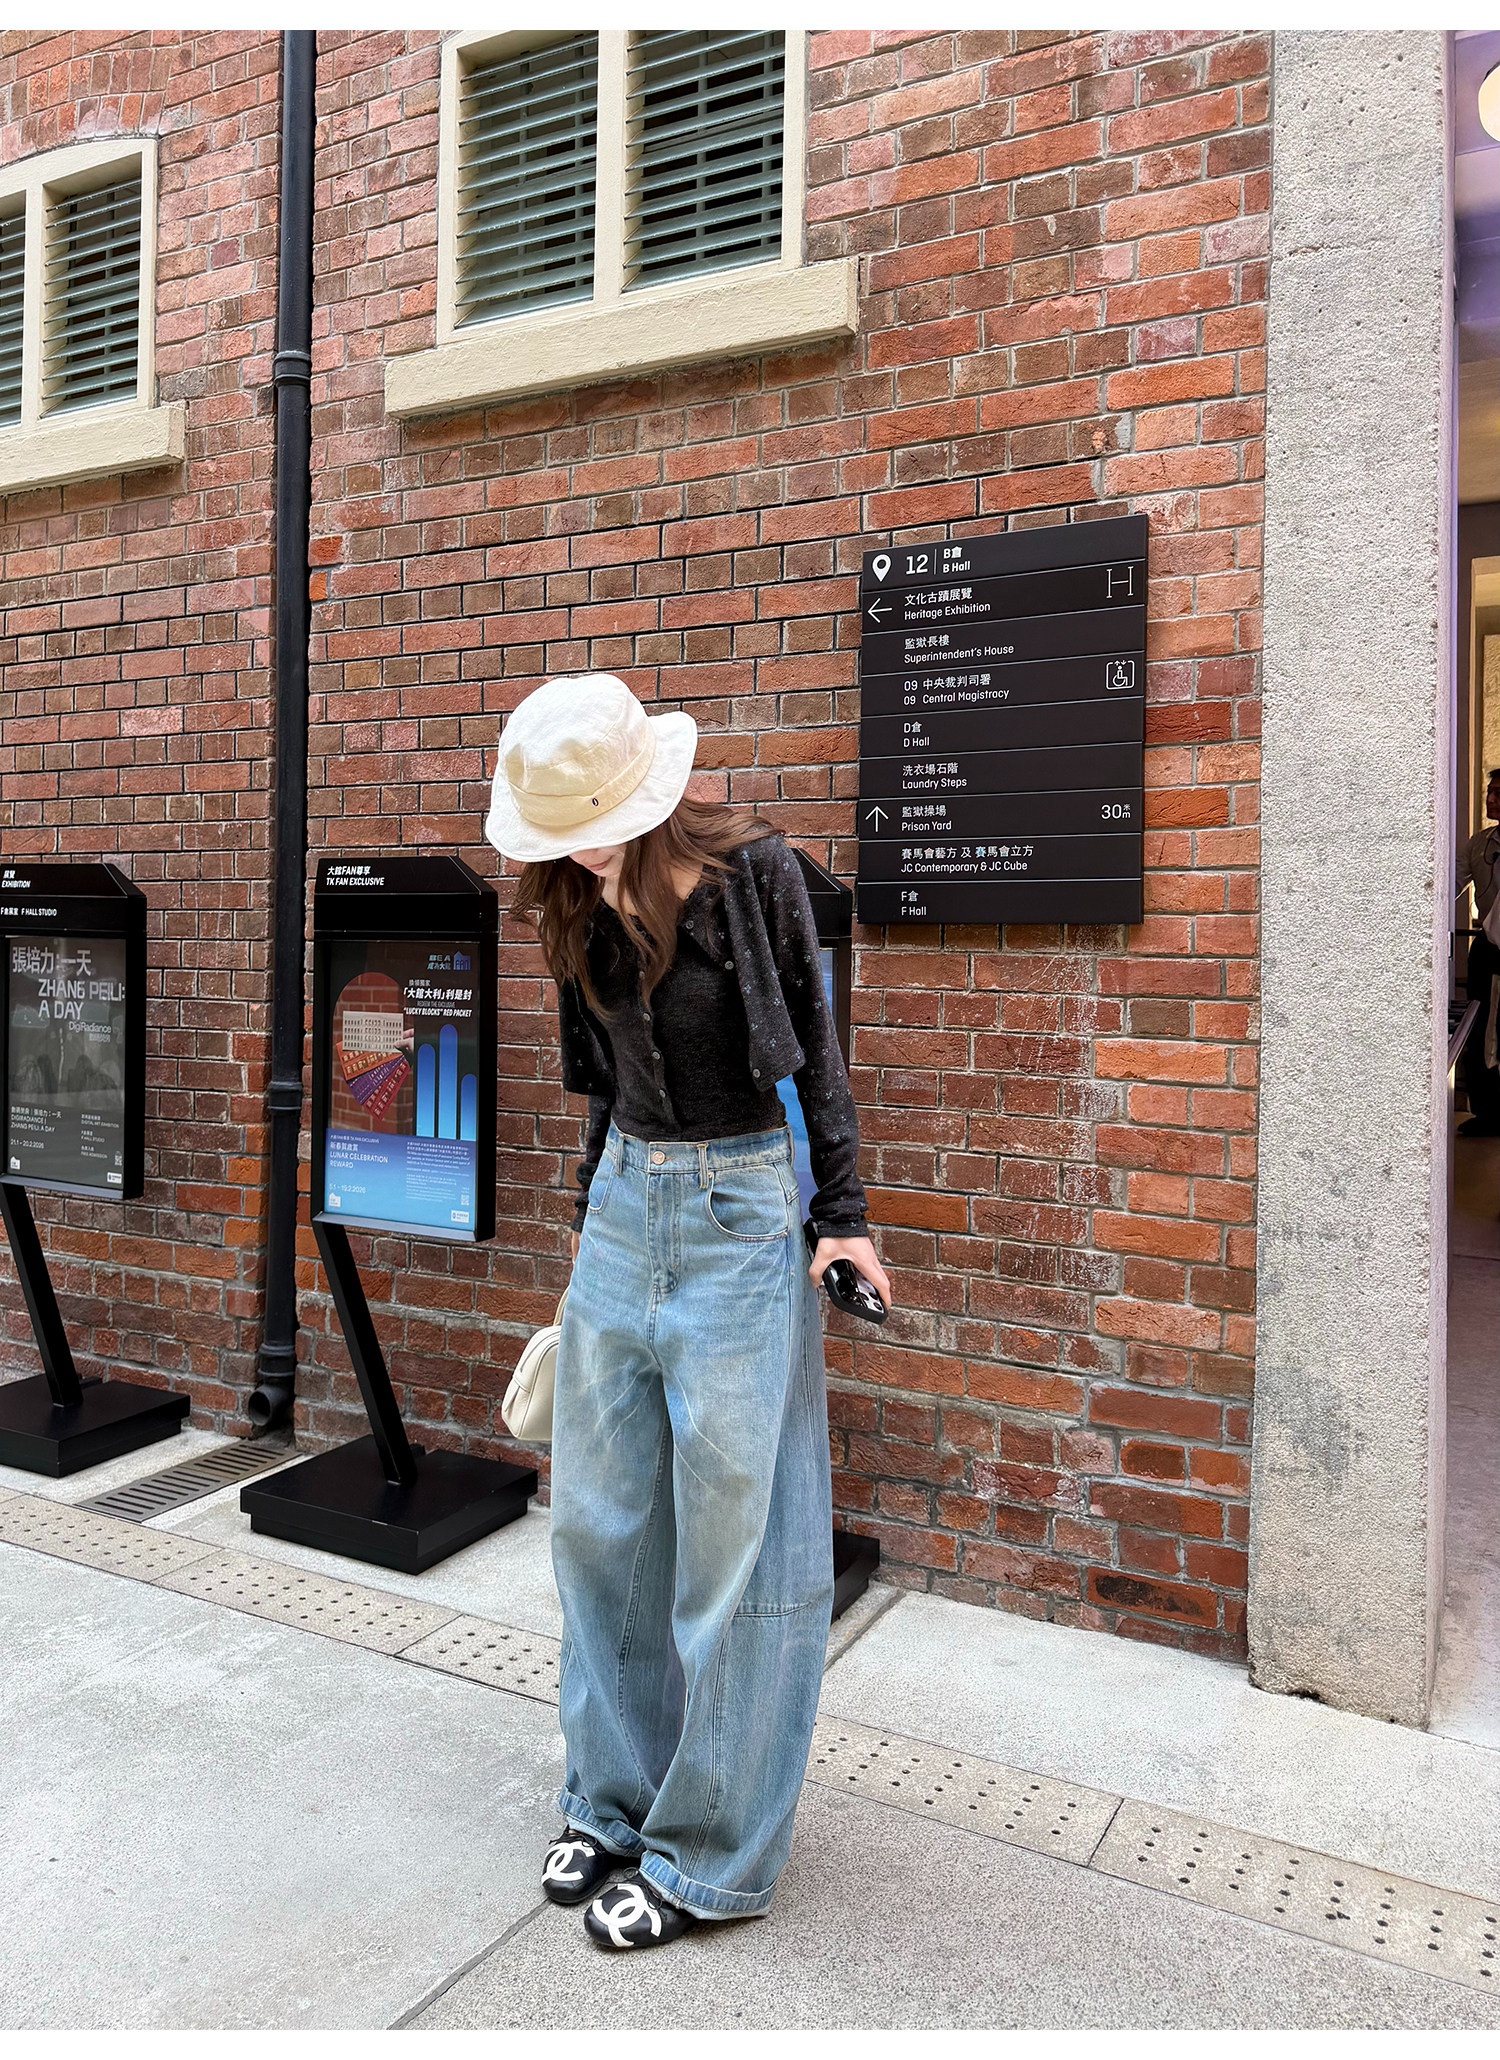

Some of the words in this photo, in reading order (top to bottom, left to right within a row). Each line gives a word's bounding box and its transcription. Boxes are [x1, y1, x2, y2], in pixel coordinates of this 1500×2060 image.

[944, 546, 962, 558] B倉
[906, 554, 928, 574] 12
[943, 564, 950, 574] B
[952, 561, 970, 572] Hall
[904, 587, 972, 607] 文化古蹟展覽
[904, 608, 943, 621] Heritage
[945, 602, 991, 616] Exhibition
[904, 634, 950, 650] 監獄長樓
[984, 644, 1014, 655] House
[904, 680, 918, 691] 09
[923, 673, 991, 690] 中央裁判司署
[904, 695, 916, 705] 09
[923, 692, 955, 704] Central
[958, 688, 1009, 701] Magistracy
[904, 721, 922, 734] D倉
[904, 738, 910, 747] D
[912, 737, 930, 747] Hall
[902, 762, 958, 776] 洗衣場石階
[902, 778, 939, 790] Laundry
[941, 777, 967, 788] Steps
[902, 805, 946, 818] 監獄操場
[1101, 804, 1121, 820] 30
[902, 821, 929, 831] Prison
[932, 821, 952, 830] Yard
[901, 847, 957, 860] 賽馬會藝方
[961, 846, 972, 858] 及
[975, 845, 1033, 858] 賽馬會立方
[901, 863, 913, 873] JC
[915, 862, 978, 874] Contemporary
[980, 862, 987, 872] &
[989, 861, 1001, 871] JC
[1004, 861, 1028, 871] Cube
[2, 880, 31, 888] EXHIBITION
[326, 878, 335, 886] TK
[335, 878, 348, 886] FAN
[349, 877, 385, 886] EXCLUSIVE
[901, 890, 918, 902] F倉
[38, 908, 57, 916] STUDIO
[901, 907, 906, 916] F
[909, 906, 927, 916] Hall
[38, 979, 85, 999] ZHANG
[90, 982, 125, 1001] PEILI:
[404, 987, 472, 1001] 「大館大利」利是封
[38, 1000, 50, 1018] A
[54, 1001, 84, 1020] DAY
[443, 1008, 454, 1017] RED
[453, 1009, 472, 1017] PACKET
[330, 1160, 353, 1169] REWARD
[349, 1153, 388, 1163] CELEBRATION
